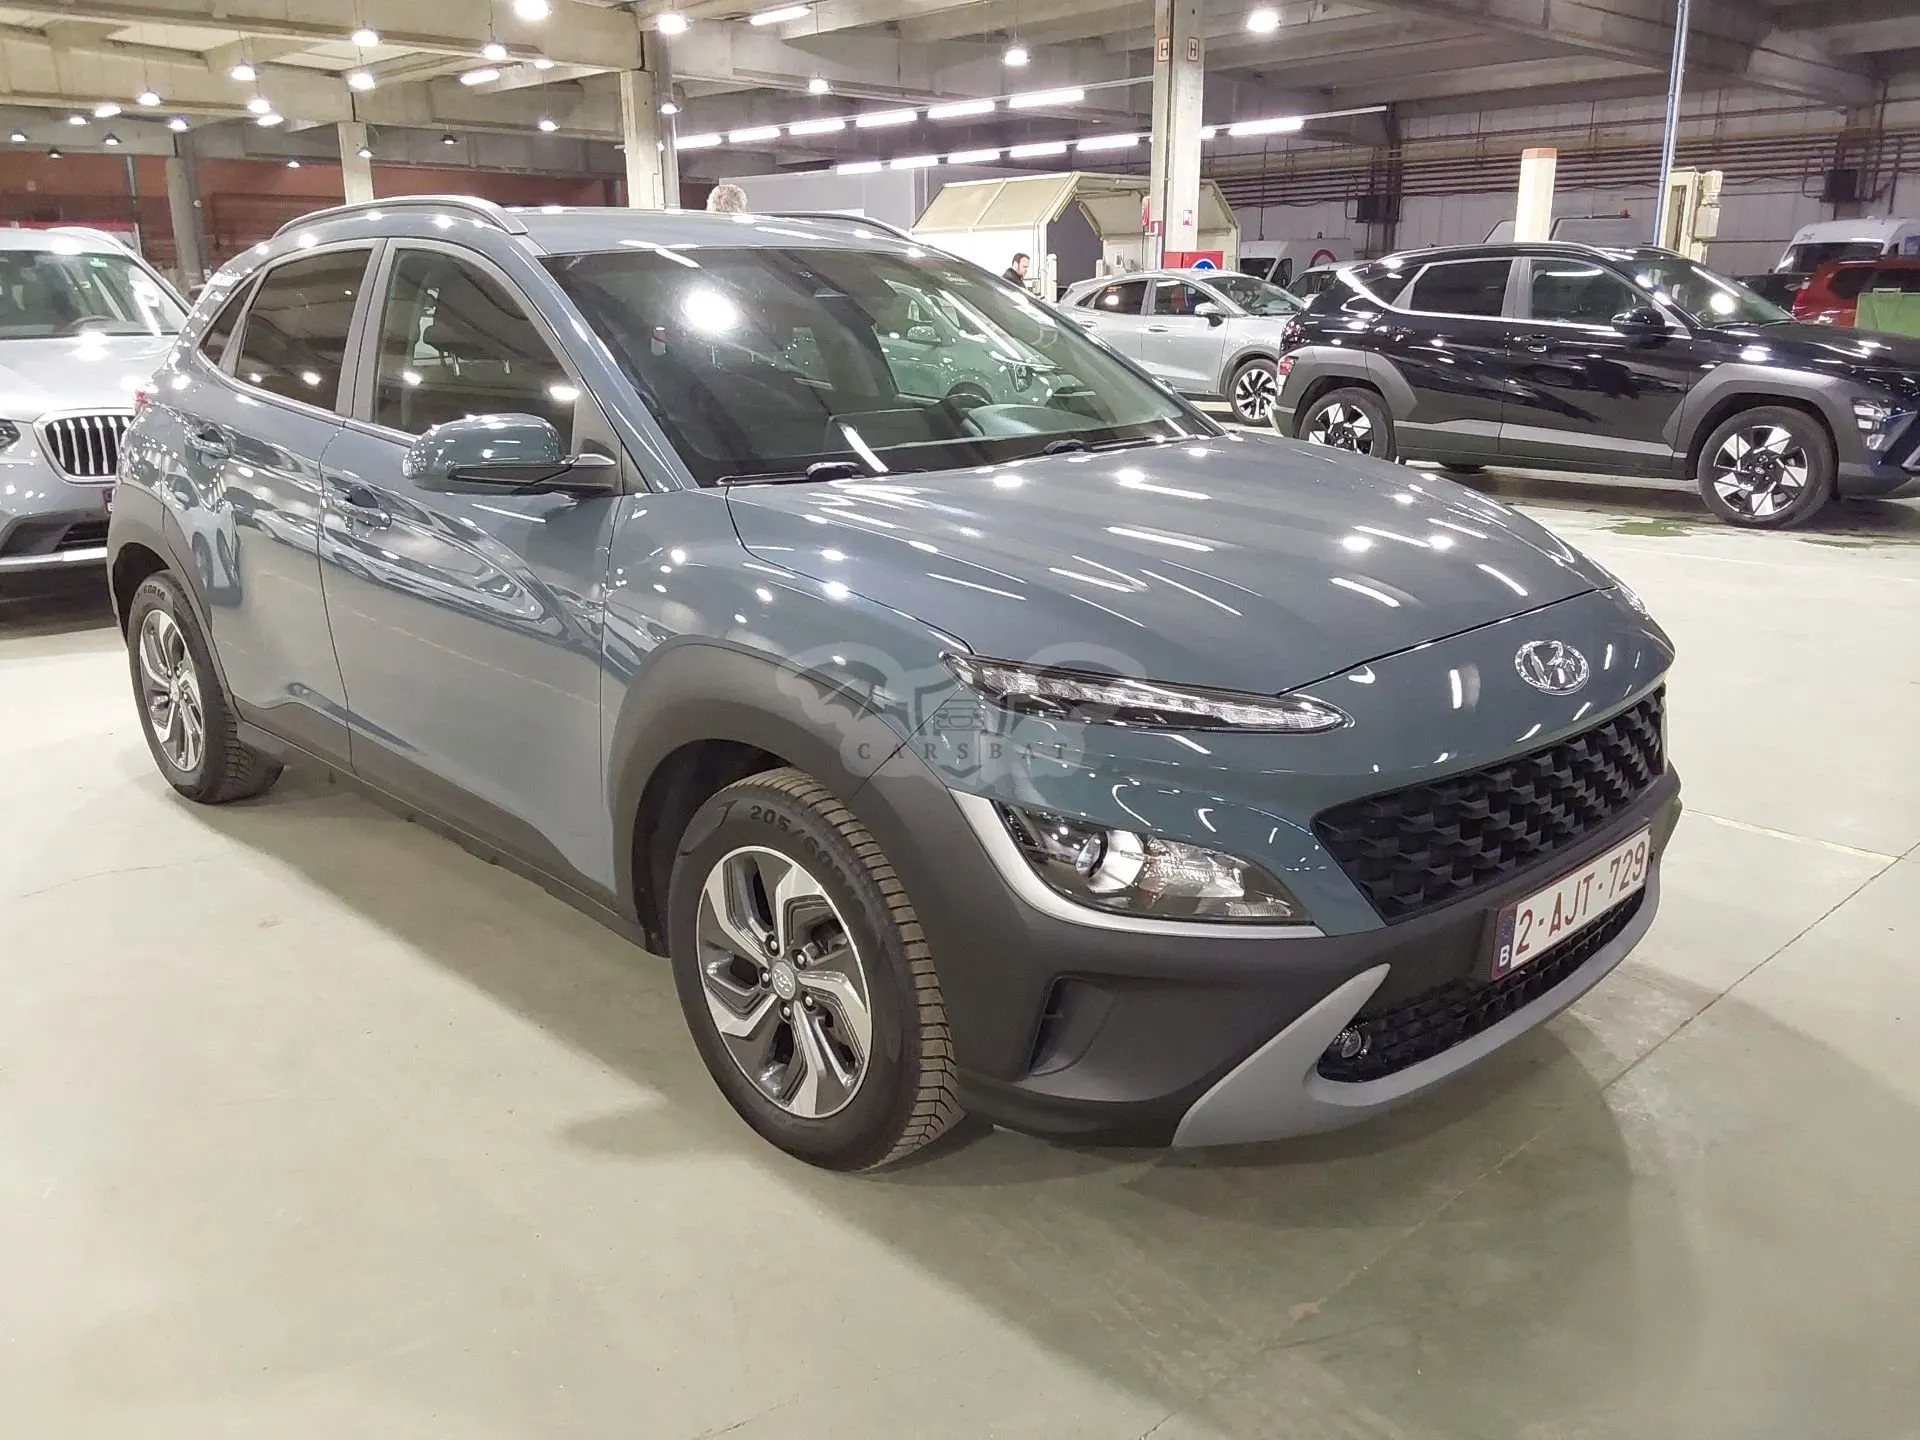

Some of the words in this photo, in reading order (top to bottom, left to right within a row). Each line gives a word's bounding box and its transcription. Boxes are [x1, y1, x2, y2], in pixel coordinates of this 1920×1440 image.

[1161, 42, 1168, 56] H
[1190, 42, 1196, 56] H
[1515, 841, 1646, 956] 2-AJT-729
[1498, 944, 1510, 968] B
